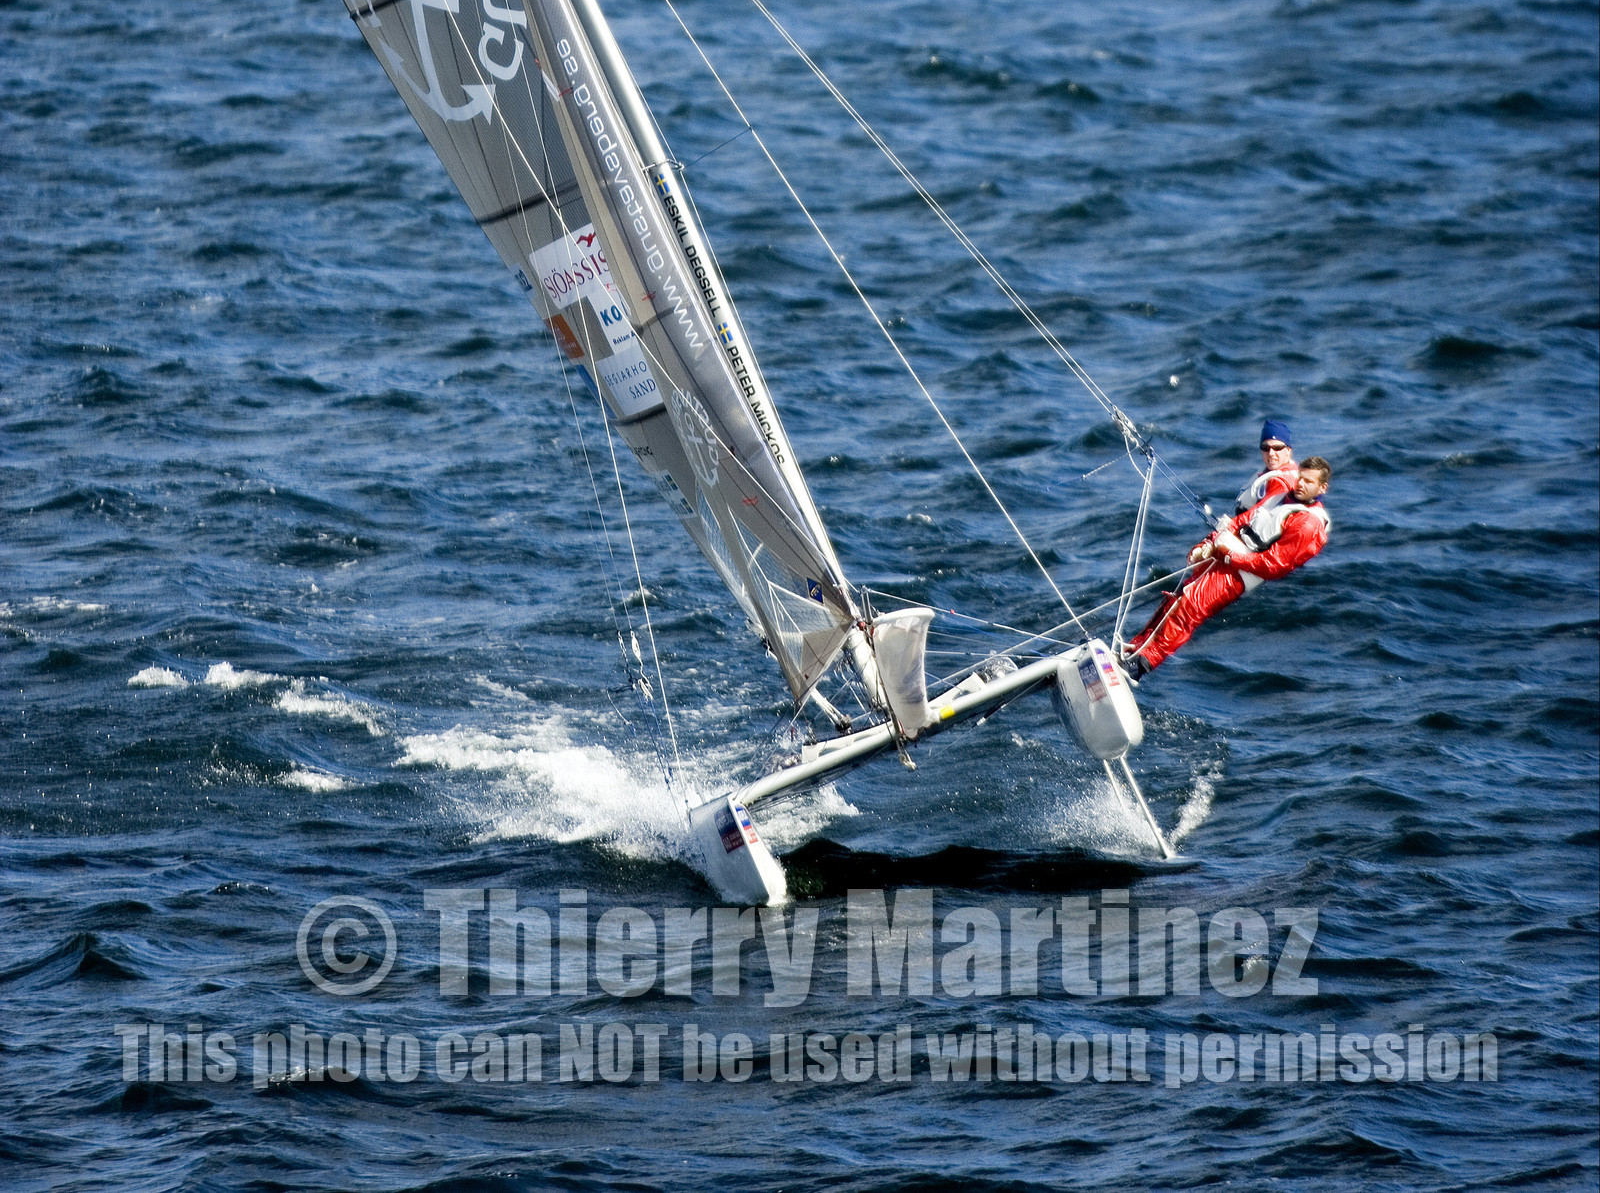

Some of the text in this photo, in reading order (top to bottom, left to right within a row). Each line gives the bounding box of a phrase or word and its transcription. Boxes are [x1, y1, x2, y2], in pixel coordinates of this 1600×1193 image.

[664, 196, 690, 244] ESKIL
[685, 245, 723, 318] DEGSELL
[727, 345, 757, 398] PETER
